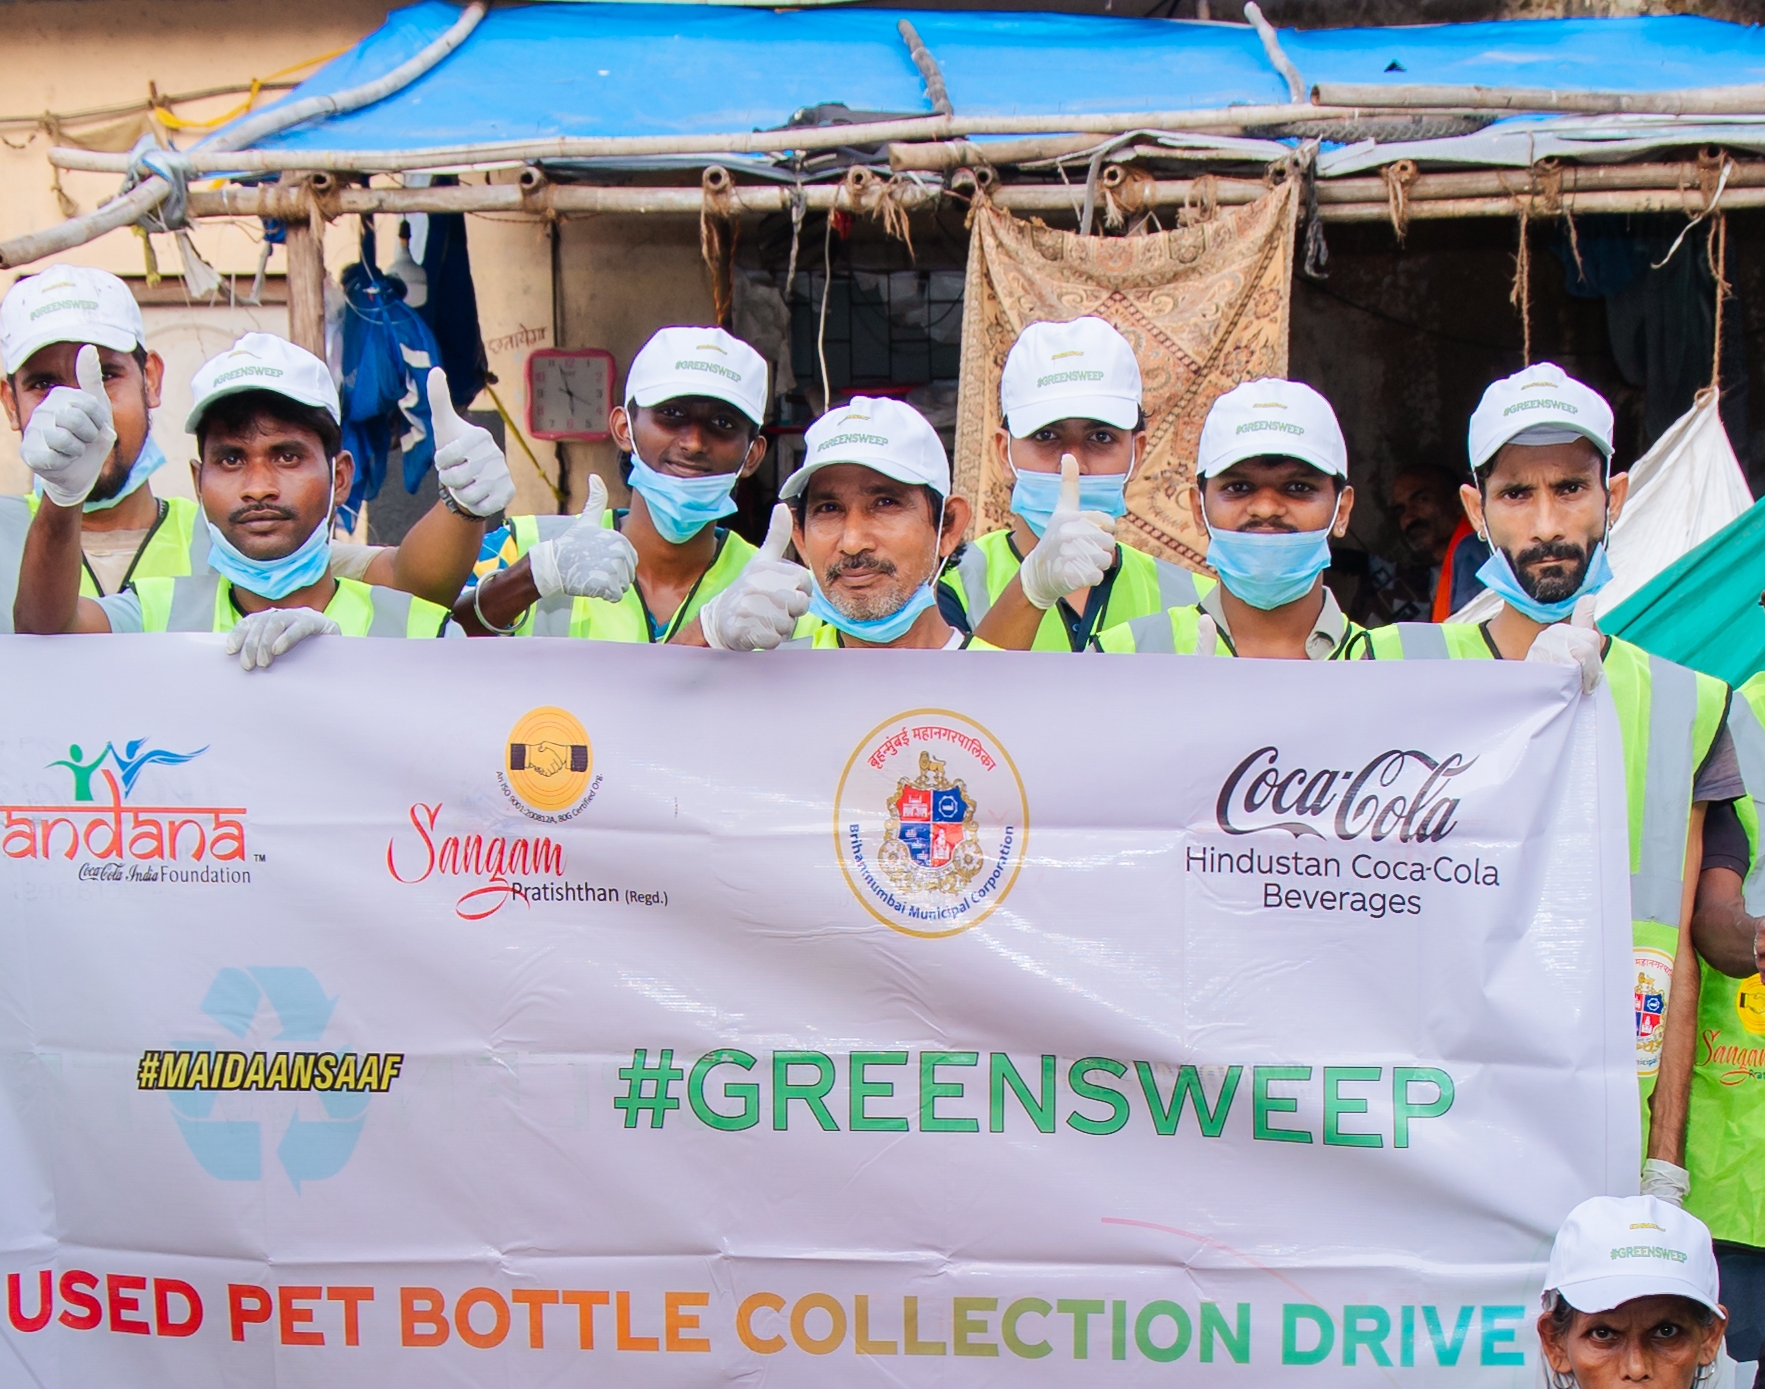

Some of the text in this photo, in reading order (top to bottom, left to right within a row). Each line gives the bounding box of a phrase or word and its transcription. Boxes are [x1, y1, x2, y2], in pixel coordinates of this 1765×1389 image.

[213, 366, 283, 388] #GREENSWEEP
[675, 360, 742, 383] #GREENSWEEP
[1037, 371, 1104, 388] #GREENSWEEP
[1503, 399, 1578, 417] #GREENSWEEP
[1236, 421, 1305, 436] #GREENSWEEP
[817, 433, 888, 453] #GREENSWEEP
[912, 726, 997, 771] महानगरपालिका
[572, 791, 596, 817] Certified
[1216, 746, 1481, 843] Coca-Cola
[125, 863, 159, 882] India
[160, 866, 252, 884] Foundation
[387, 802, 568, 921] Sangam
[908, 898, 971, 920] Municipal
[971, 826, 1014, 904] Corporation
[1186, 847, 1500, 886] Hindustan Coca-Cola
[511, 882, 668, 906] Pratishthan (Regd.)
[1264, 882, 1422, 918] Beverages
[138, 1050, 405, 1093] #MAIDAANSAAF
[613, 1047, 1456, 1149] #GREENSWEEP
[1610, 1246, 1688, 1264] #GREENSWEEP
[7, 1270, 1527, 1368] USED PET BOTTLE COLLECTION DRIVE
